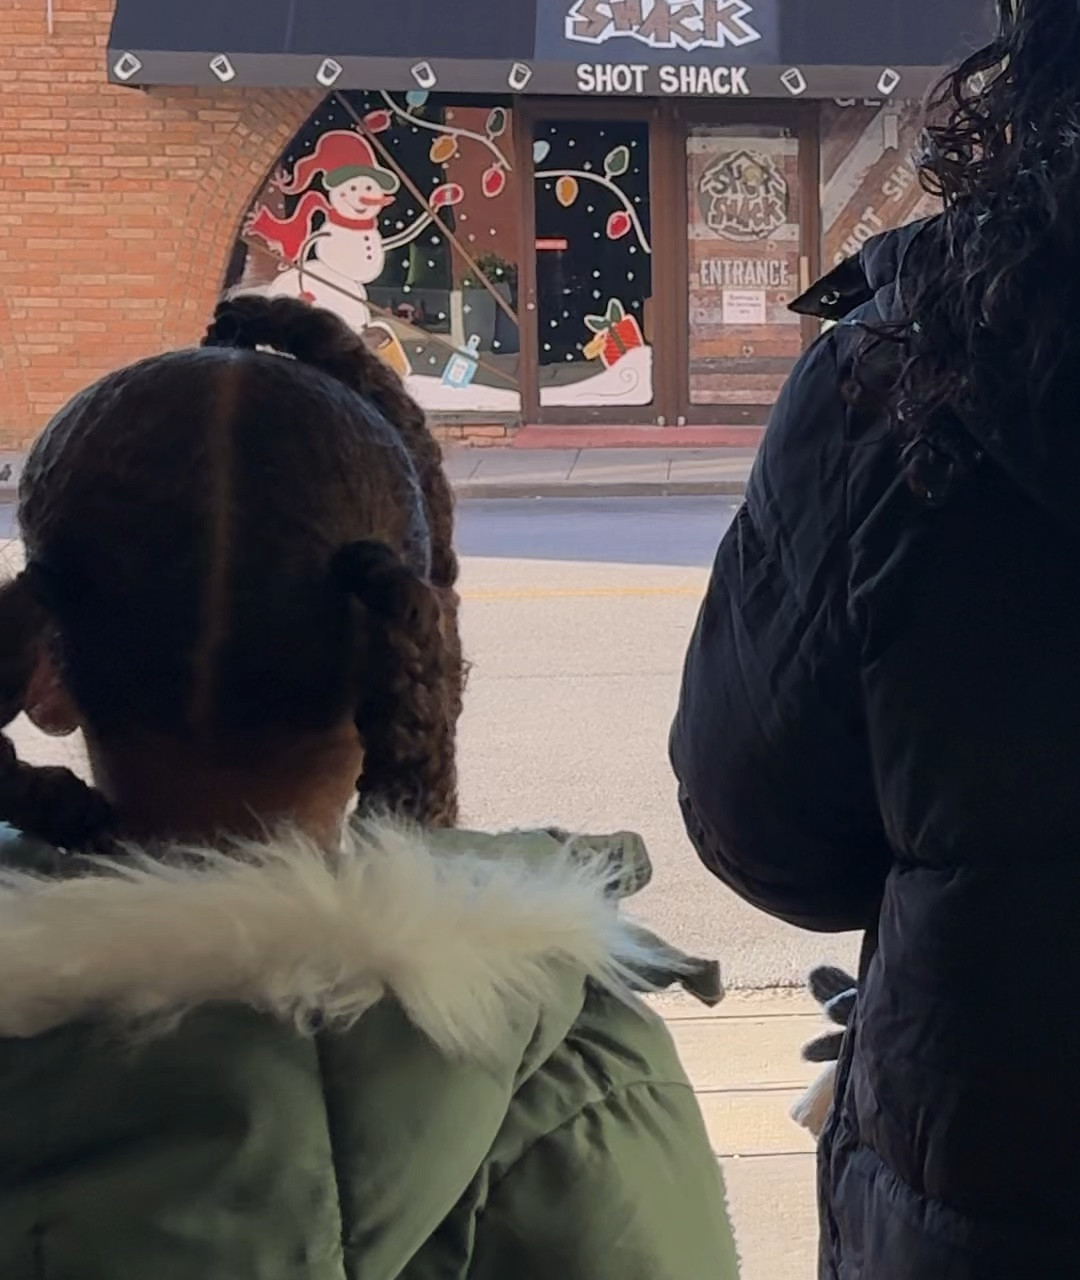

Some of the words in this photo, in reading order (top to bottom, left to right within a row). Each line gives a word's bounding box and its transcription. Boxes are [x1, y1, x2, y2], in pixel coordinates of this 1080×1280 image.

[576, 63, 649, 93] SHOT
[659, 66, 750, 95] SHACK
[700, 259, 789, 287] ENTRANCE
